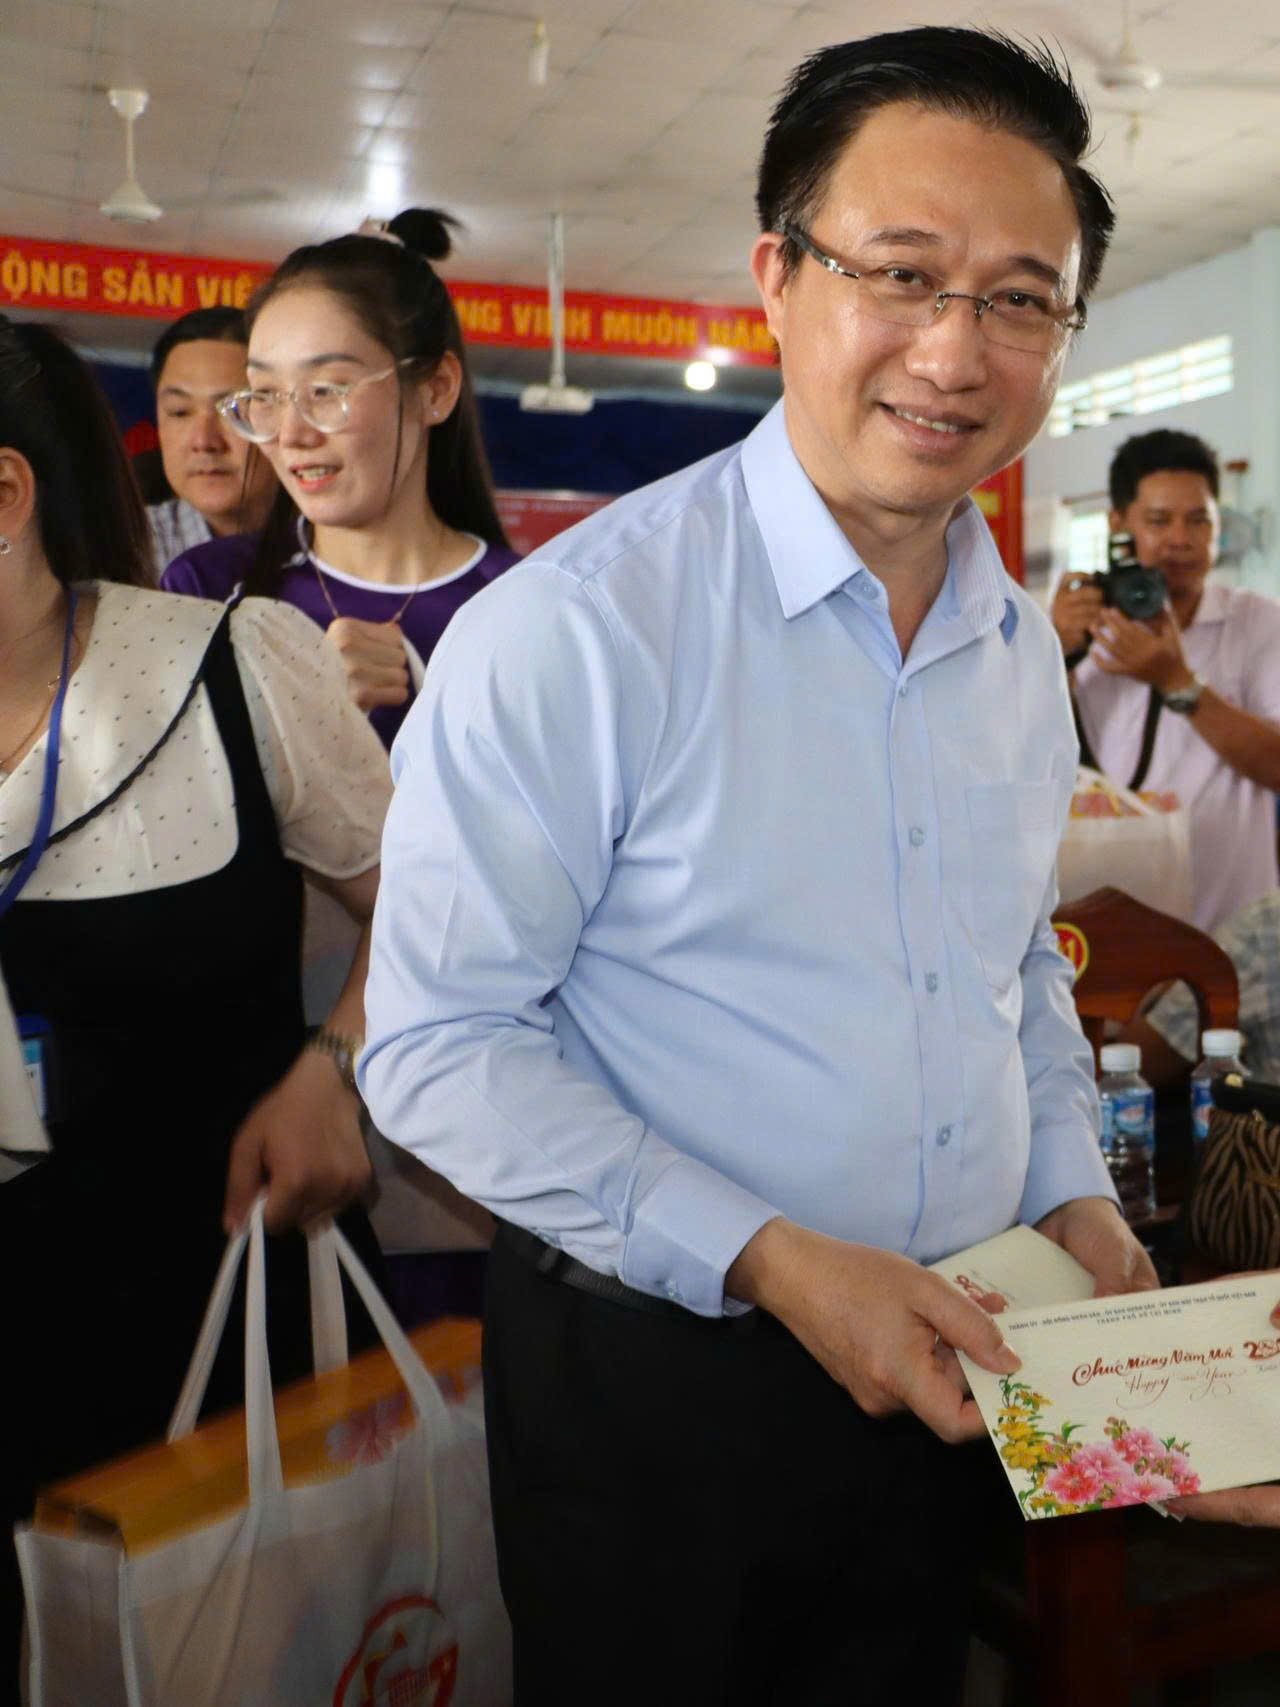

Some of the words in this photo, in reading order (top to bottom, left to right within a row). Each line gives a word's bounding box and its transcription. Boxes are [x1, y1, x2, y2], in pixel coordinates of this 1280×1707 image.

[102, 257, 184, 308] SẢN
[601, 305, 698, 346] MUÔN
[1169, 1349, 1206, 1367] Năm
